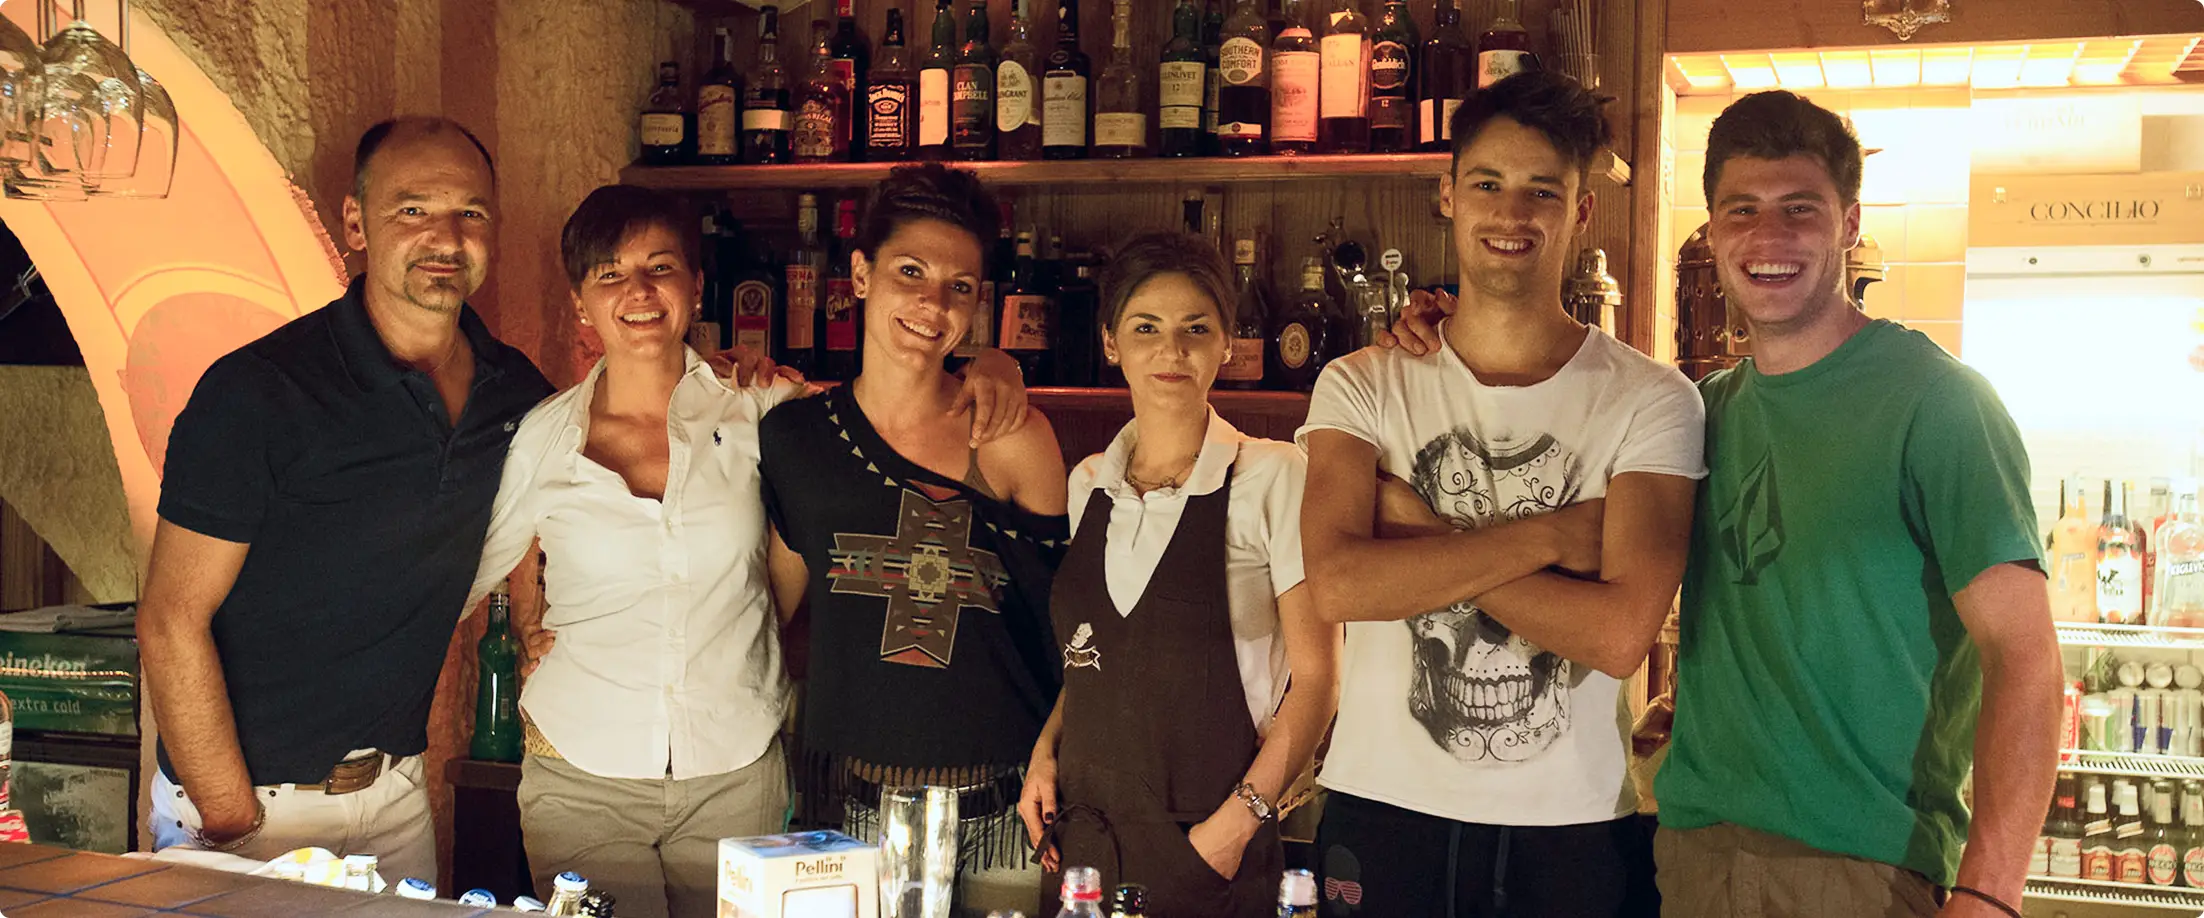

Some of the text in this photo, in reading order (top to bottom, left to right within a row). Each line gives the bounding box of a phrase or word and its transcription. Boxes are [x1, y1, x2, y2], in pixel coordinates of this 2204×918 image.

[1220, 45, 1260, 58] SOUTHERN
[1222, 60, 1257, 70] COMFORT
[956, 81, 978, 91] CLAN
[12, 696, 82, 714] extra cold
[795, 856, 846, 876] Pellini
